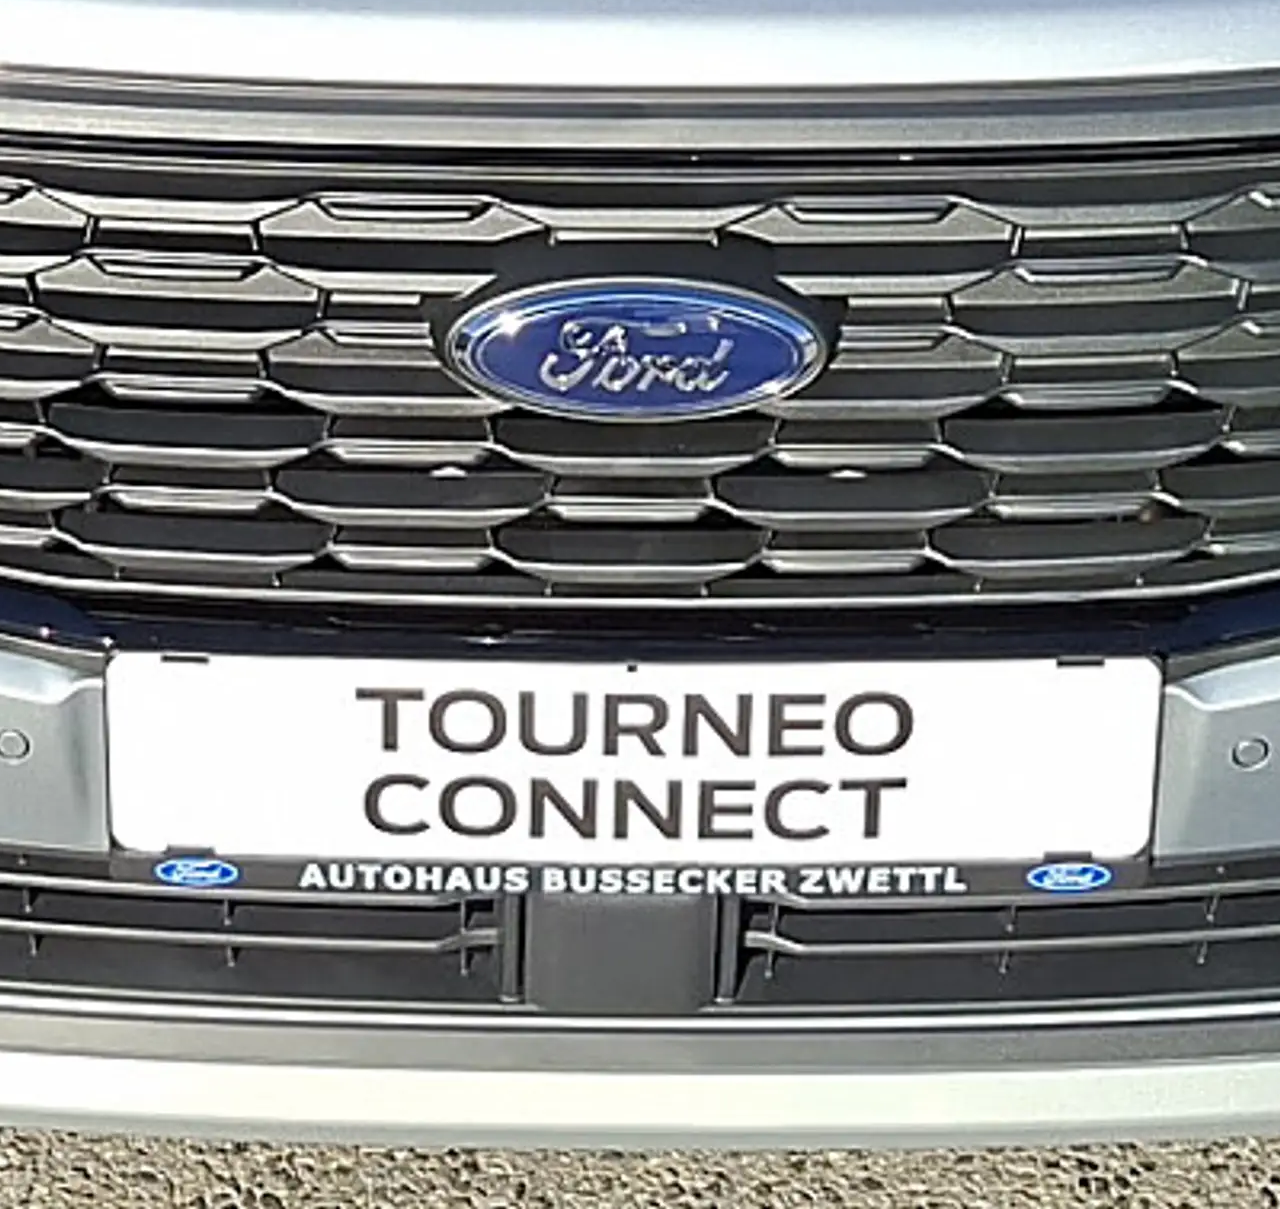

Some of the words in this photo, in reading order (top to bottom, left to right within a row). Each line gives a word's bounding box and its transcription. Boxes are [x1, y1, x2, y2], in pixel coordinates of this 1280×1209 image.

[539, 316, 734, 392] Ford
[355, 688, 914, 757] TOURNEO
[364, 774, 908, 841] CONNECT
[299, 862, 529, 893] AUTOHAUS
[542, 866, 787, 895] BUSSECKER
[799, 865, 967, 894] ZWETTL
